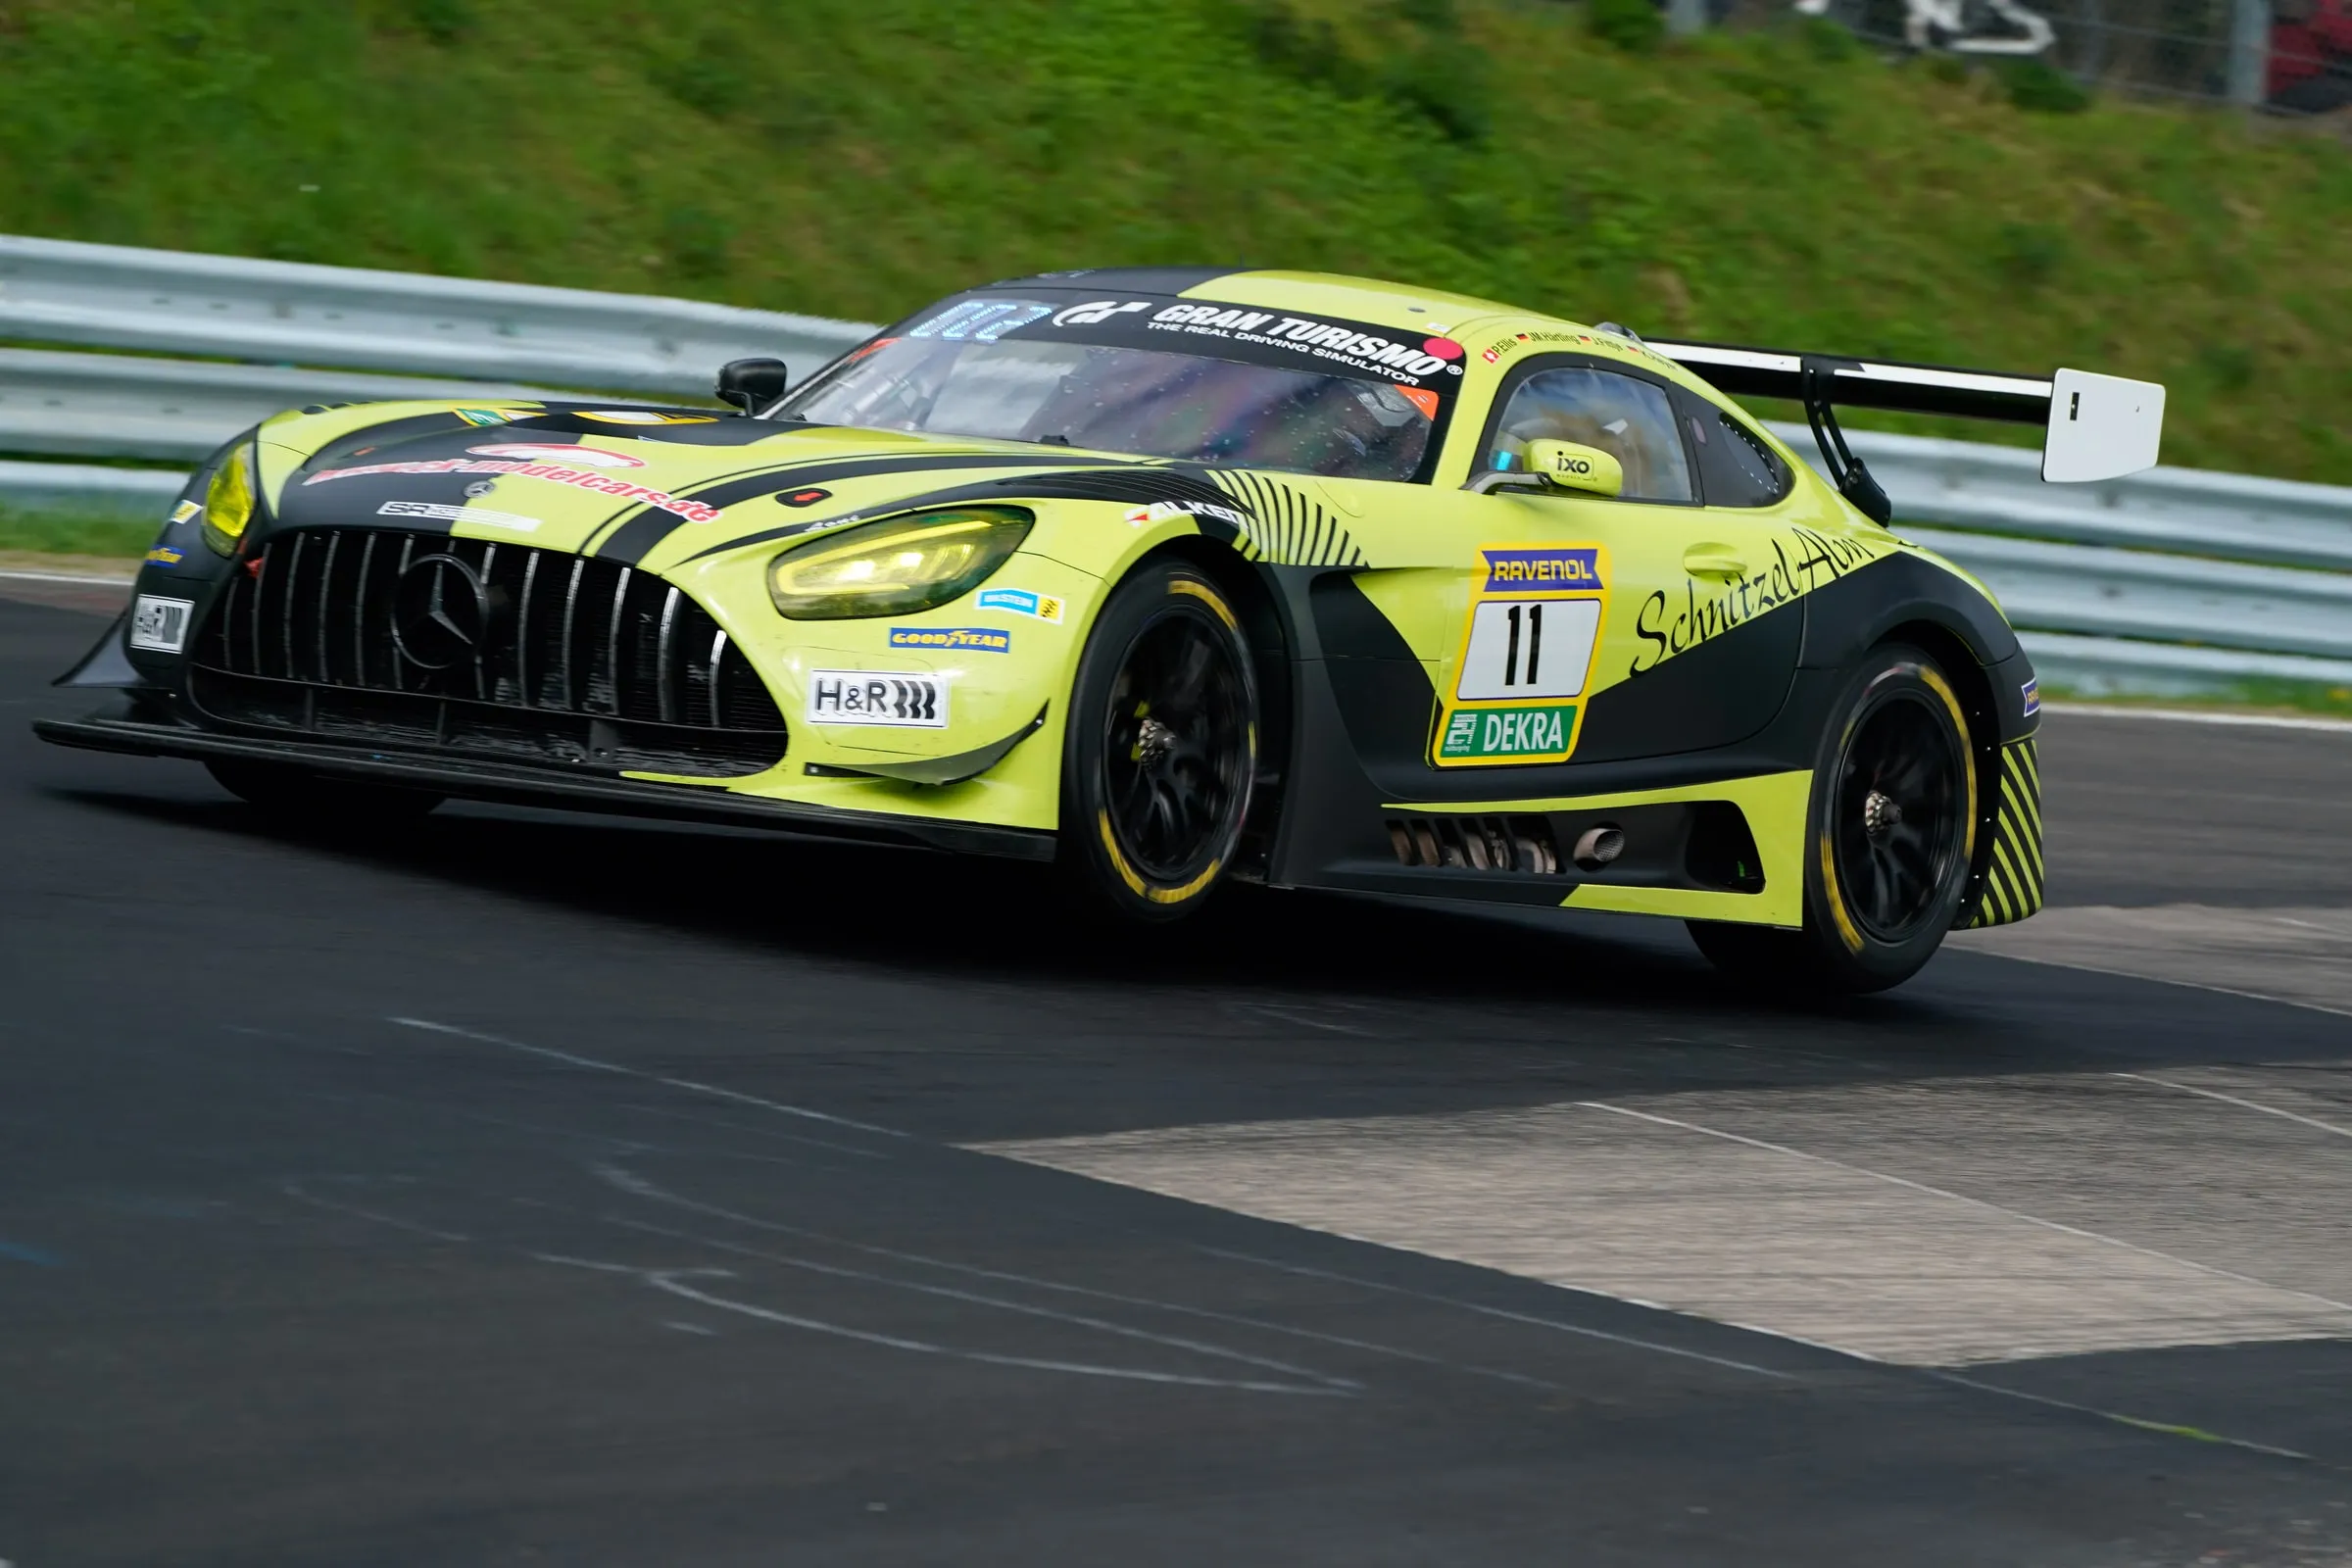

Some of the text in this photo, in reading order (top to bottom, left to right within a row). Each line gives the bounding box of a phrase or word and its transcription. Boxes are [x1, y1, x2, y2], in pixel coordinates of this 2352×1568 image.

[1152, 304, 1275, 331] GRAN
[1147, 321, 1420, 386] THE REAL DRIVING SIMULATOR
[1556, 450, 1590, 474] ixo
[1493, 559, 1593, 581] RAVENOL
[891, 630, 1008, 649] GOODYEAR
[1504, 604, 1543, 686] 11
[814, 678, 888, 713] H&R
[1482, 710, 1564, 753] DEKRA
